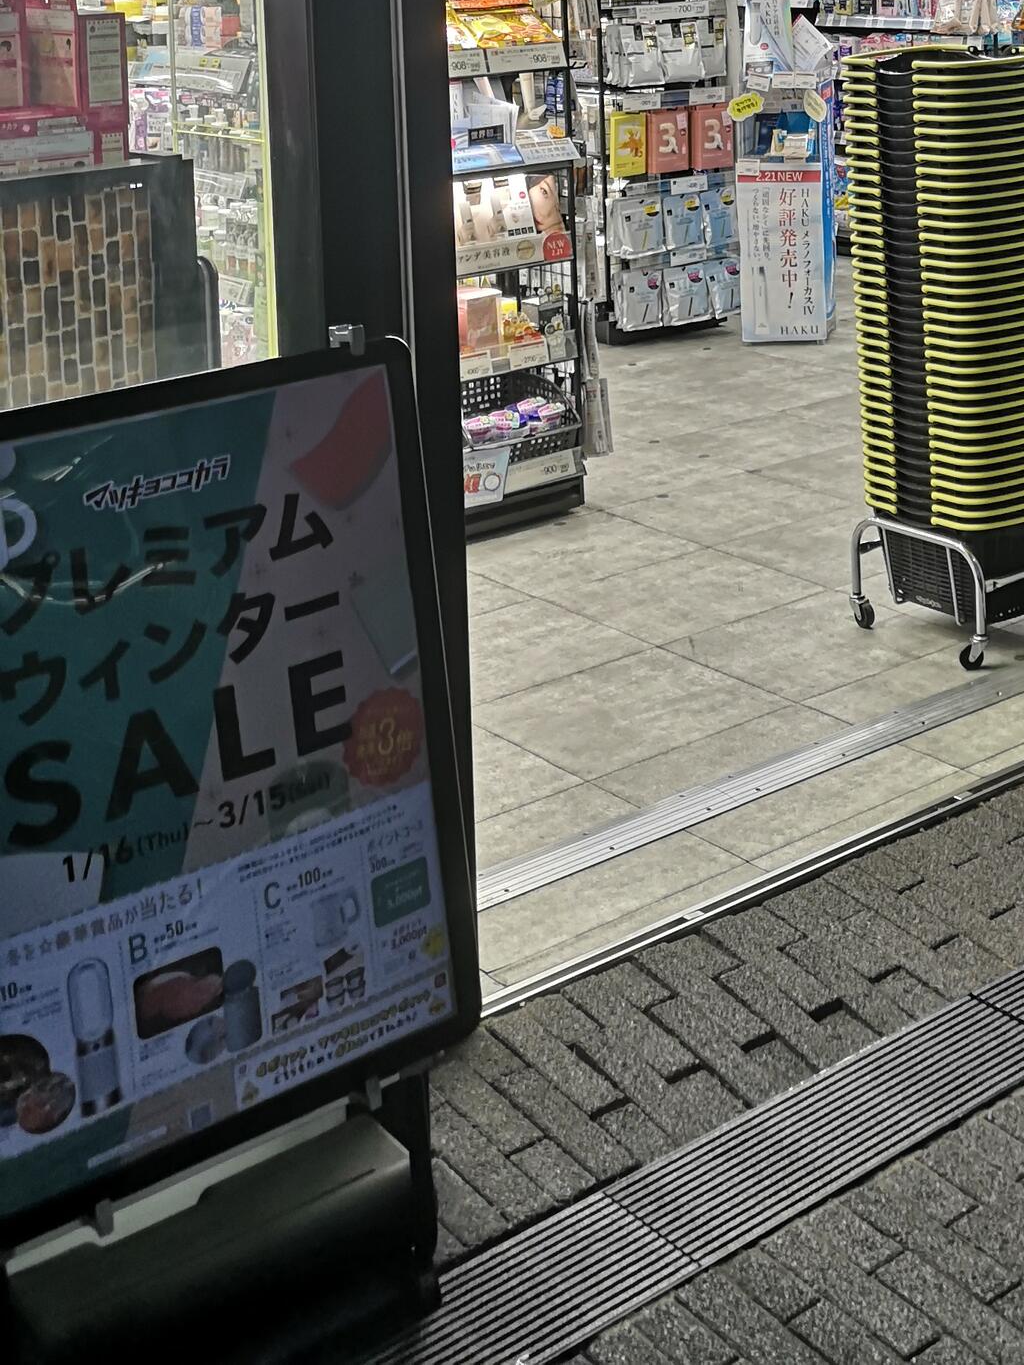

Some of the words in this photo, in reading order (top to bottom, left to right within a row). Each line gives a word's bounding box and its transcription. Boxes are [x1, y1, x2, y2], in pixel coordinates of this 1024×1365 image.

[779, 187, 798, 309] 好評発売中!
[780, 325, 819, 335] HAKU
[0, 493, 335, 634] プレミアム
[3, 649, 355, 848] SALE
[264, 880, 282, 912] C
[128, 933, 149, 966] B
